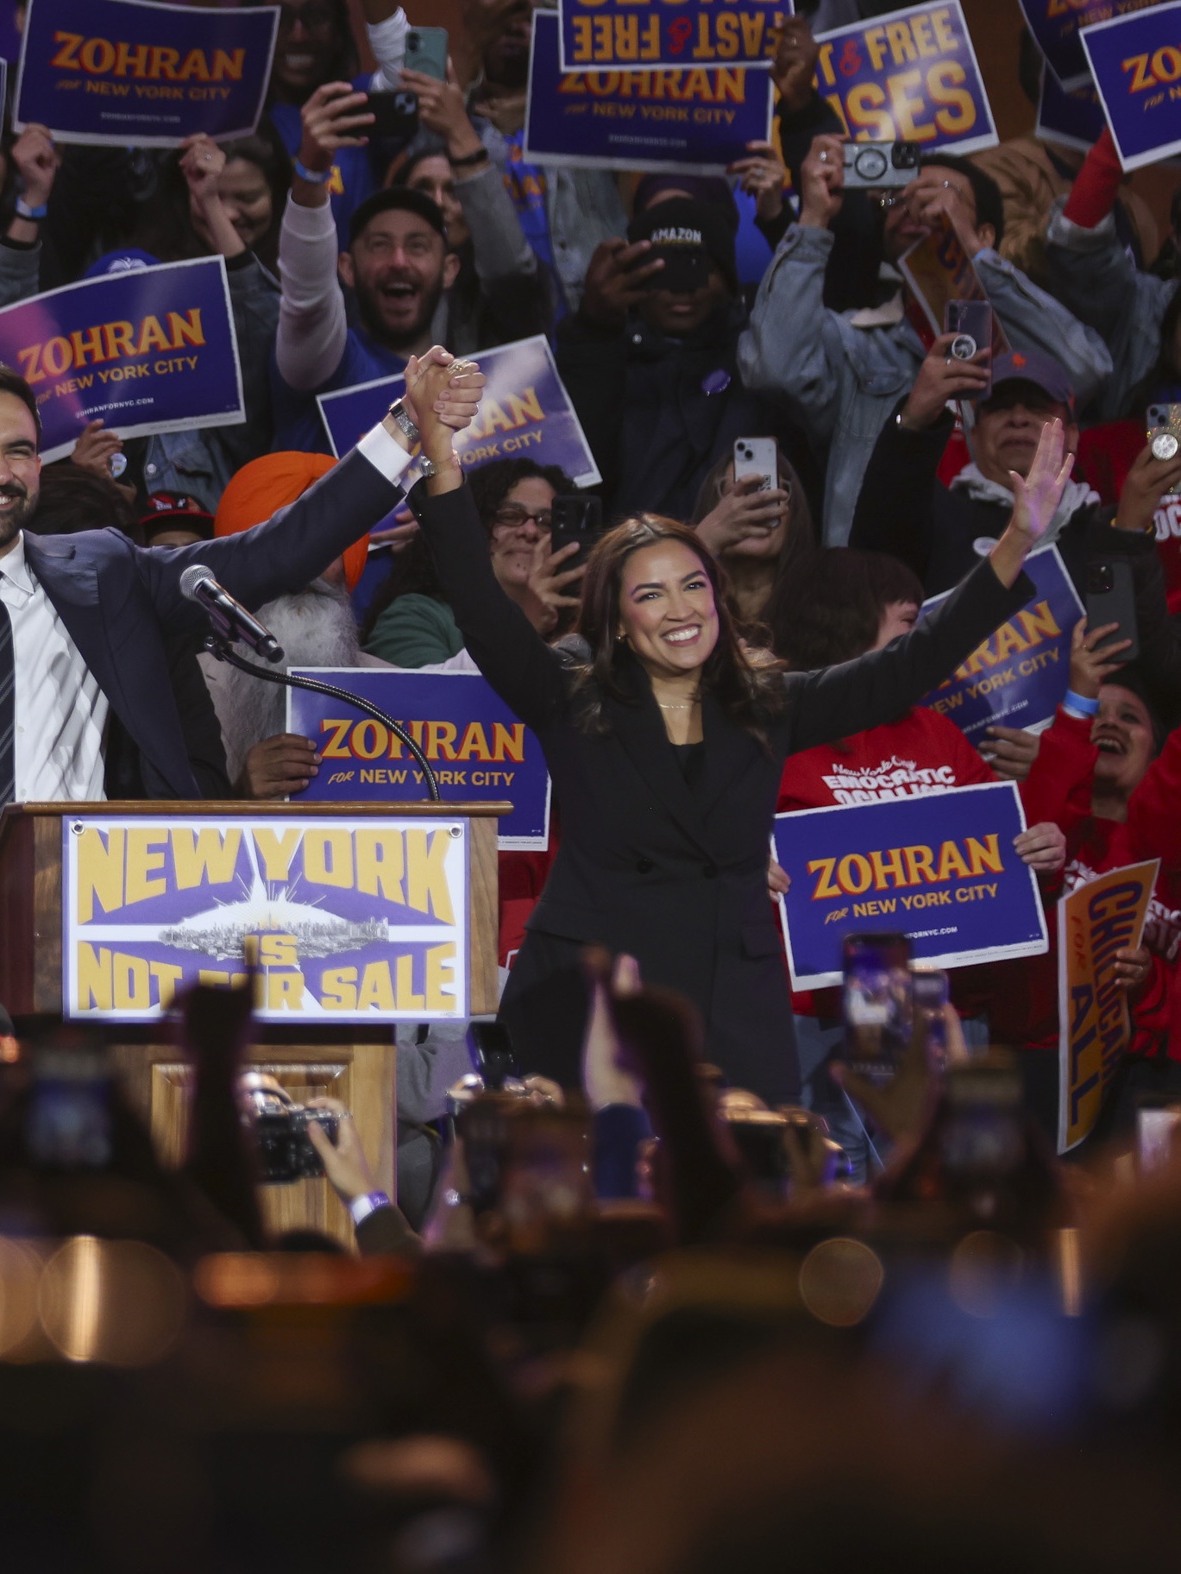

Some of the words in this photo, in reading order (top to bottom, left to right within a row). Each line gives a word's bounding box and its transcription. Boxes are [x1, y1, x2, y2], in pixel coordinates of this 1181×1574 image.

[50, 31, 245, 81] ZOHRAN
[572, 14, 661, 61] FREE
[864, 9, 959, 71] FREE
[86, 81, 130, 96] NEW
[134, 85, 184, 99] YORK
[189, 86, 231, 99] CITY
[557, 68, 745, 103] ZOHRAN
[831, 59, 977, 145] SES
[592, 103, 635, 117] NEW
[641, 106, 689, 122] YORK
[694, 108, 736, 125] CITY
[651, 227, 702, 243] AMAZON
[17, 308, 207, 385] ZOHRAN
[55, 373, 93, 397] NEW
[98, 363, 150, 383] YORK
[154, 355, 198, 375] CITY
[462, 444, 500, 465] ORK
[503, 430, 543, 452] CITY
[966, 667, 1017, 698] YORK
[1019, 647, 1059, 676] CITY
[320, 719, 525, 763] ZOHRAN
[360, 769, 407, 785] NEW
[413, 770, 466, 785] YRK
[471, 772, 515, 786] CITY
[821, 765, 956, 789] EMOCRATIC
[77, 828, 243, 925] NEW
[251, 828, 456, 926] YORK
[808, 833, 1005, 901] ZOHRAN
[853, 897, 897, 917] NEW
[901, 890, 952, 909] YORK
[955, 882, 998, 902] CITY
[244, 934, 298, 966] IS
[77, 941, 183, 1011] NOT
[321, 942, 456, 1011] SALE
[1071, 984, 1100, 1126] ALL
